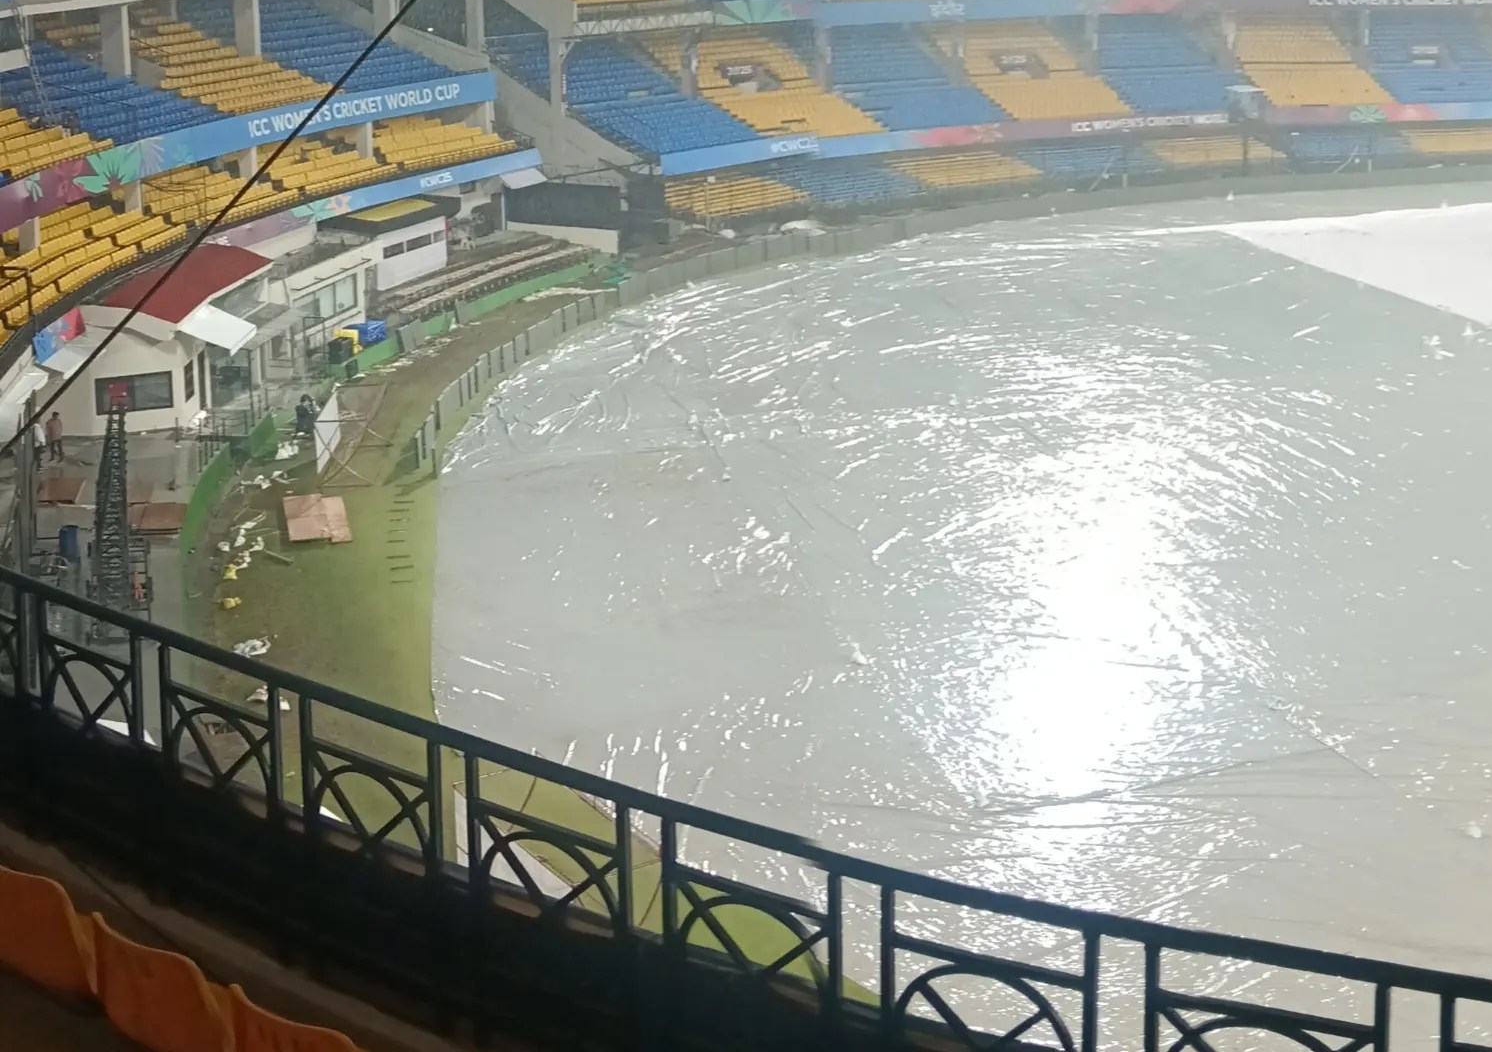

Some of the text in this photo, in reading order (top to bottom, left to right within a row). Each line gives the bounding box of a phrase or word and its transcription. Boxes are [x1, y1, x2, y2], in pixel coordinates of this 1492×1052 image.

[248, 120, 270, 138] ICC
[332, 96, 382, 121] CRICKET
[385, 88, 433, 110] WORLD
[435, 83, 461, 103] CUP
